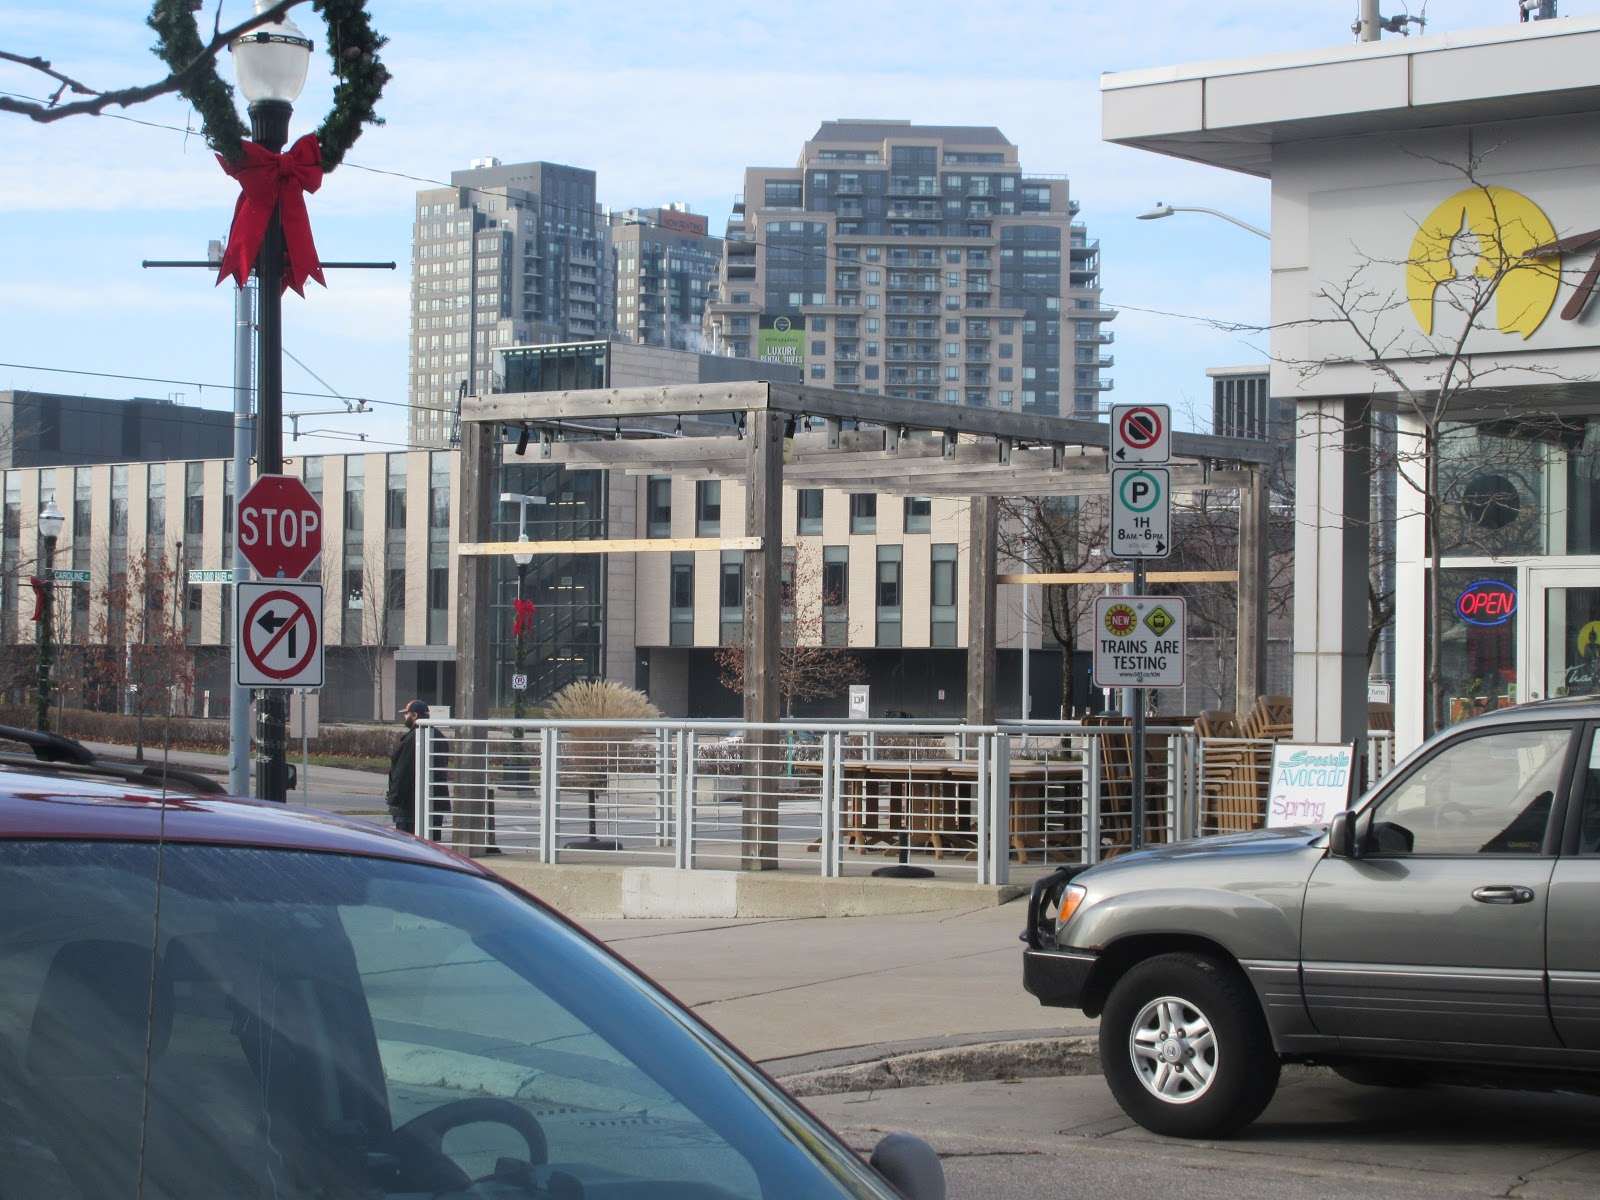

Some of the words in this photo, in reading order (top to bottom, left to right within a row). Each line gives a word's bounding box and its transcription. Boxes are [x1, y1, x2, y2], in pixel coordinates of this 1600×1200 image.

[767, 345, 797, 356] LUXURY
[1132, 482, 1149, 503] P
[241, 507, 319, 548] STOP
[1133, 516, 1150, 528] 1H
[54, 571, 84, 580] CAROLINE
[189, 571, 203, 581] FATHER
[203, 571, 214, 581] DAVID
[214, 571, 228, 581] BAUER
[1460, 592, 1514, 615] OPEN
[1111, 615, 1130, 626] NEW
[1101, 640, 1148, 654] TRAINS
[1154, 640, 1179, 654] ARE
[1113, 656, 1167, 670] TESTING
[1278, 750, 1350, 769] Specials
[1272, 795, 1326, 822] Spring
